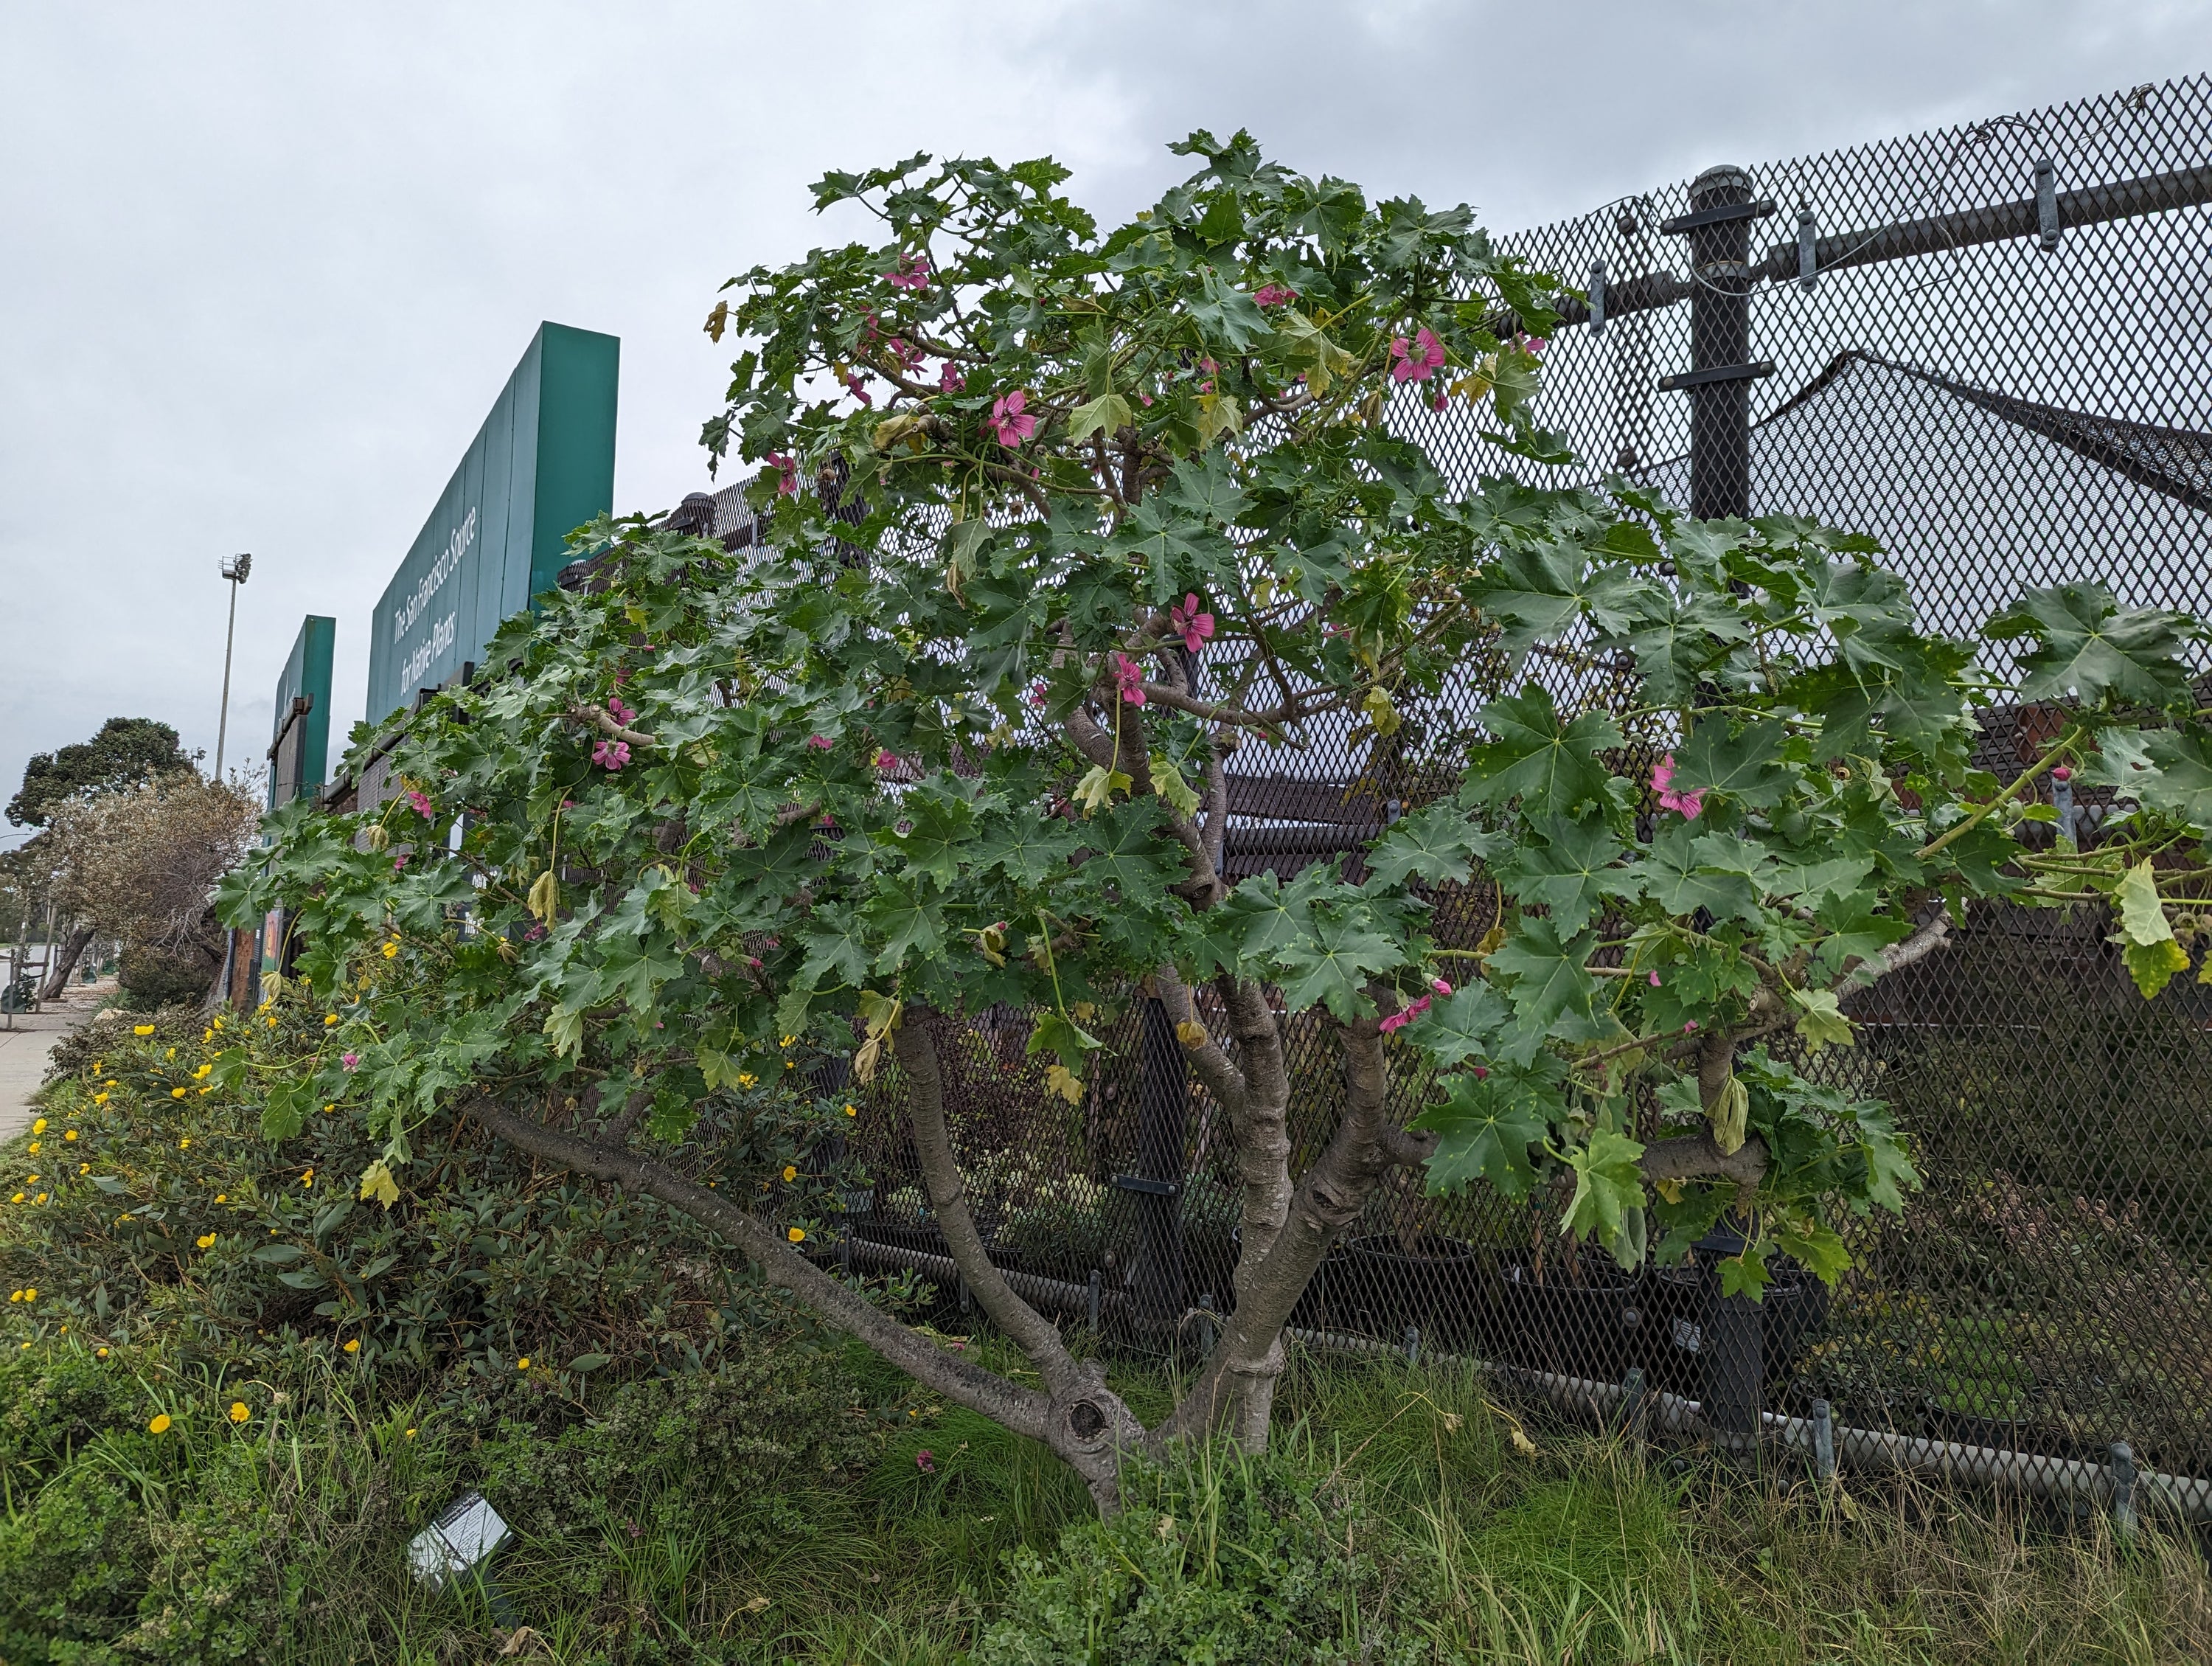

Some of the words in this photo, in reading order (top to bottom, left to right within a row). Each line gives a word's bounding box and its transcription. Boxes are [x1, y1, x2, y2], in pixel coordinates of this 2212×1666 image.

[395, 607, 406, 645] The
[405, 594, 417, 631] San
[417, 548, 449, 617] Francisco
[449, 506, 476, 572] Source
[400, 658, 412, 696] for
[410, 638, 431, 687] Native
[431, 611, 456, 663] Plants
